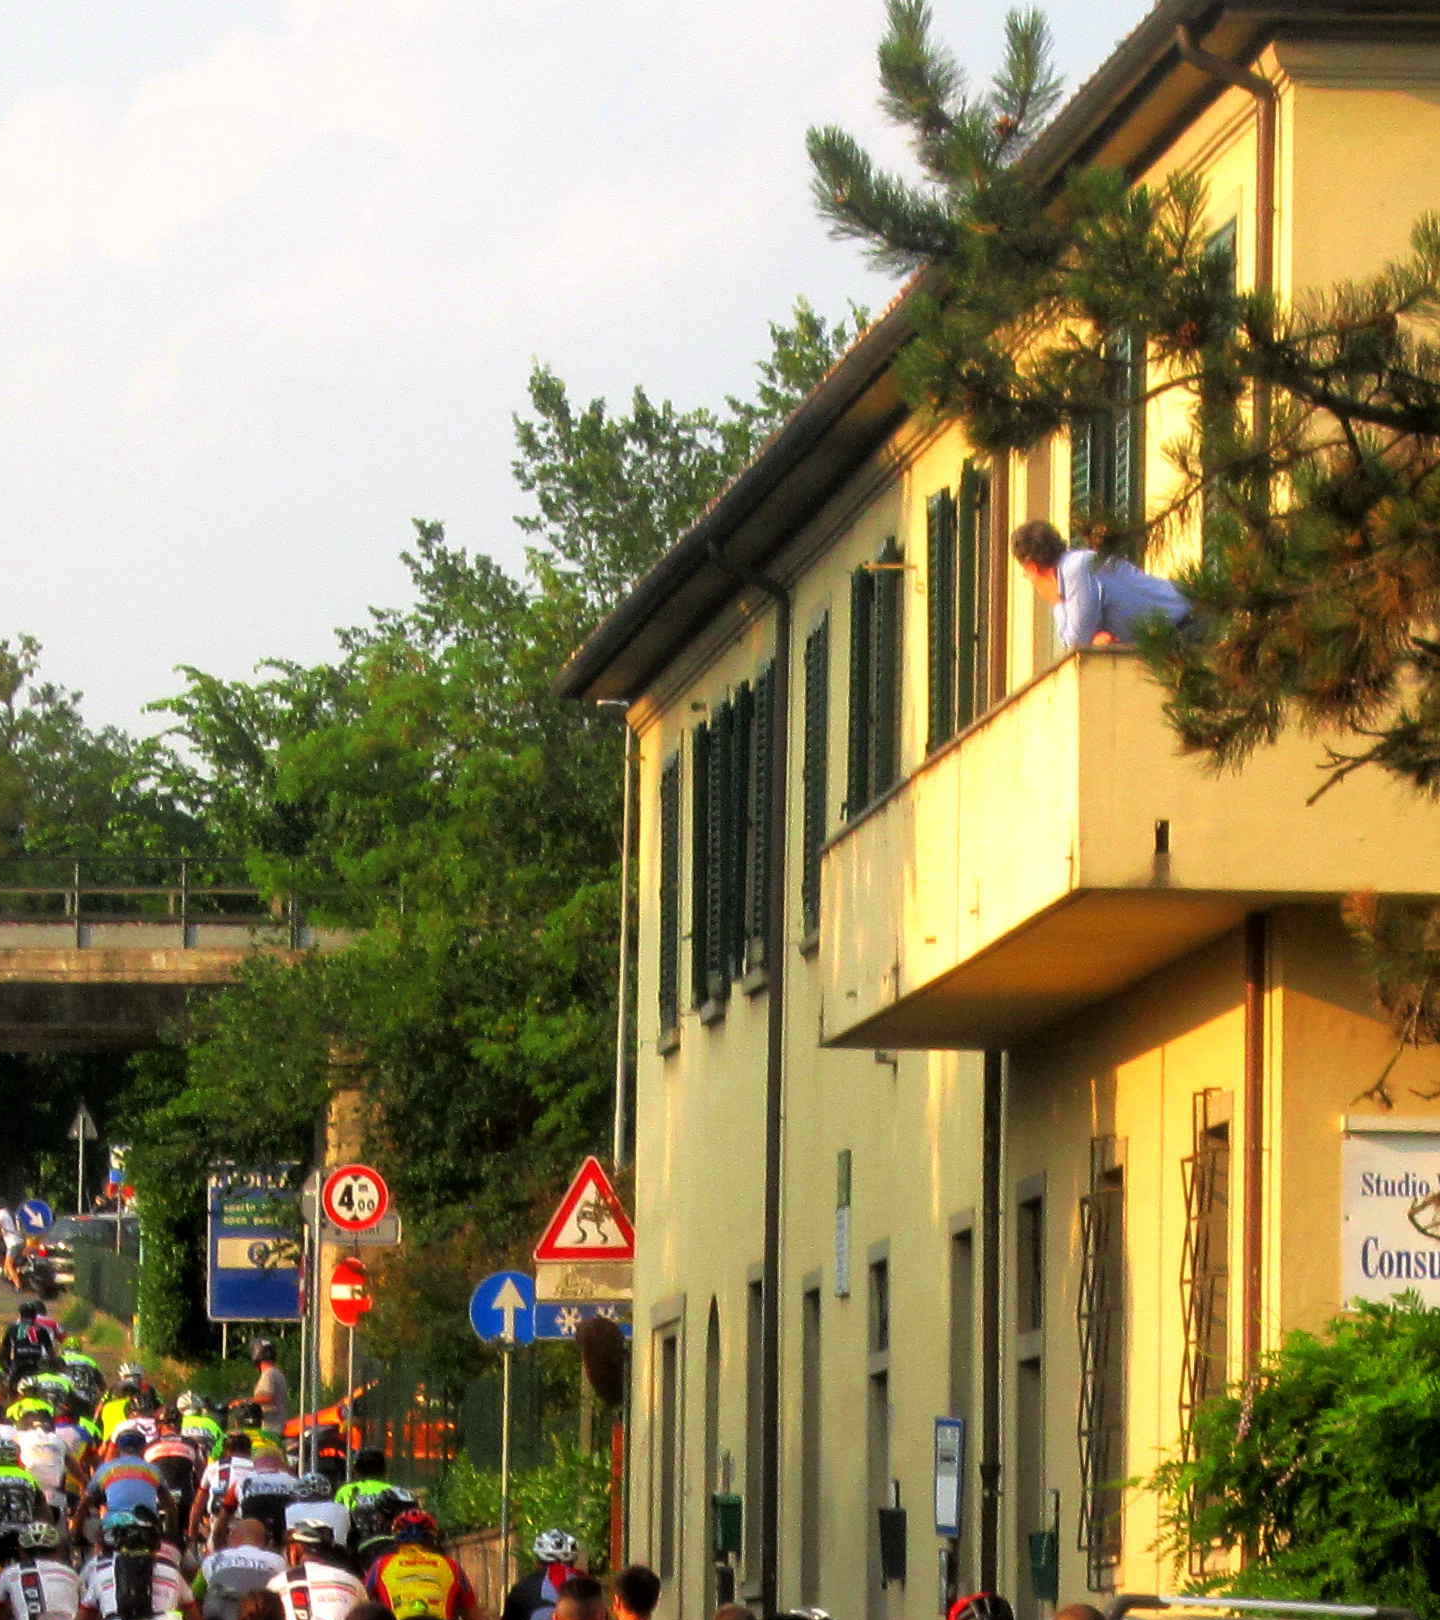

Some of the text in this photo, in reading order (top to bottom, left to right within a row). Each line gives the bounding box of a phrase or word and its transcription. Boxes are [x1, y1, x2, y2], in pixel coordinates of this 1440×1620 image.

[338, 1182, 355, 1213] 4
[357, 1199, 376, 1212] 00
[1361, 1172, 1430, 1197] Studio
